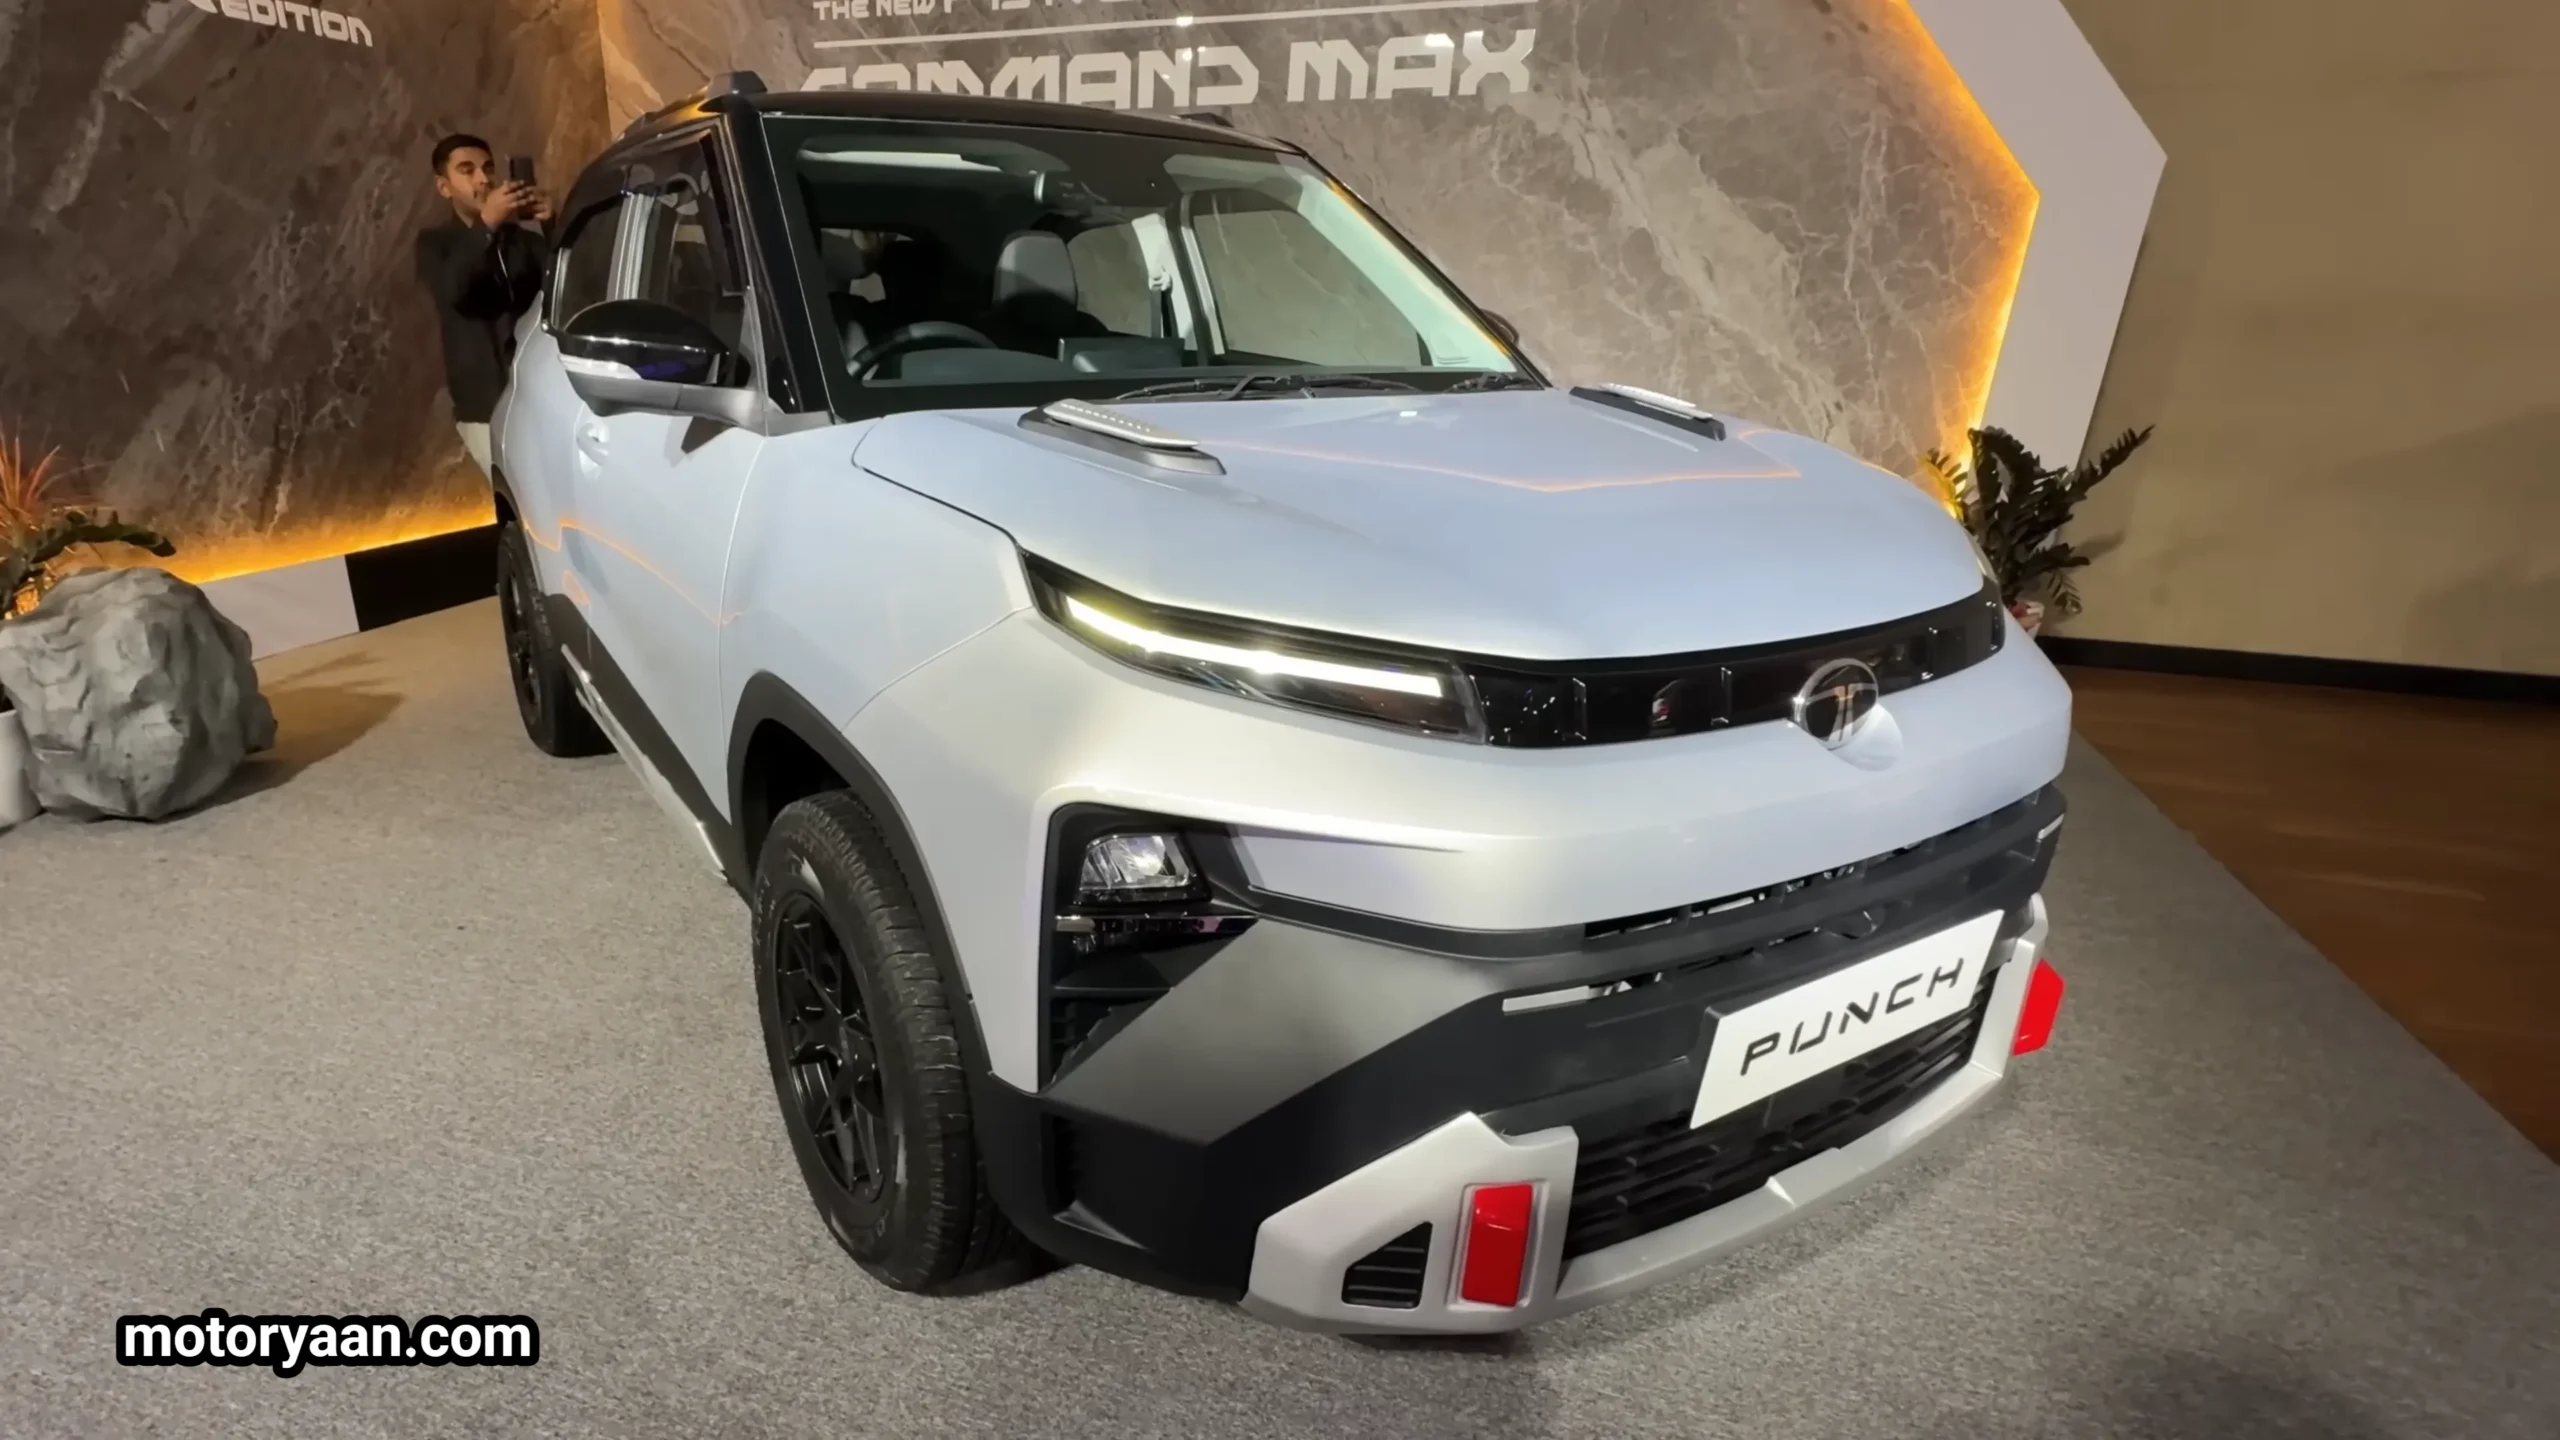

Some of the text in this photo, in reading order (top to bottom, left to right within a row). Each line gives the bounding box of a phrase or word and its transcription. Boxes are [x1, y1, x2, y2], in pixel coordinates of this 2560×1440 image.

[221, 0, 373, 47] EDITION
[813, 0, 869, 20] THE
[875, 0, 936, 17] NEW
[1287, 29, 1536, 103] MAX
[1740, 957, 1964, 1076] PUNCH
